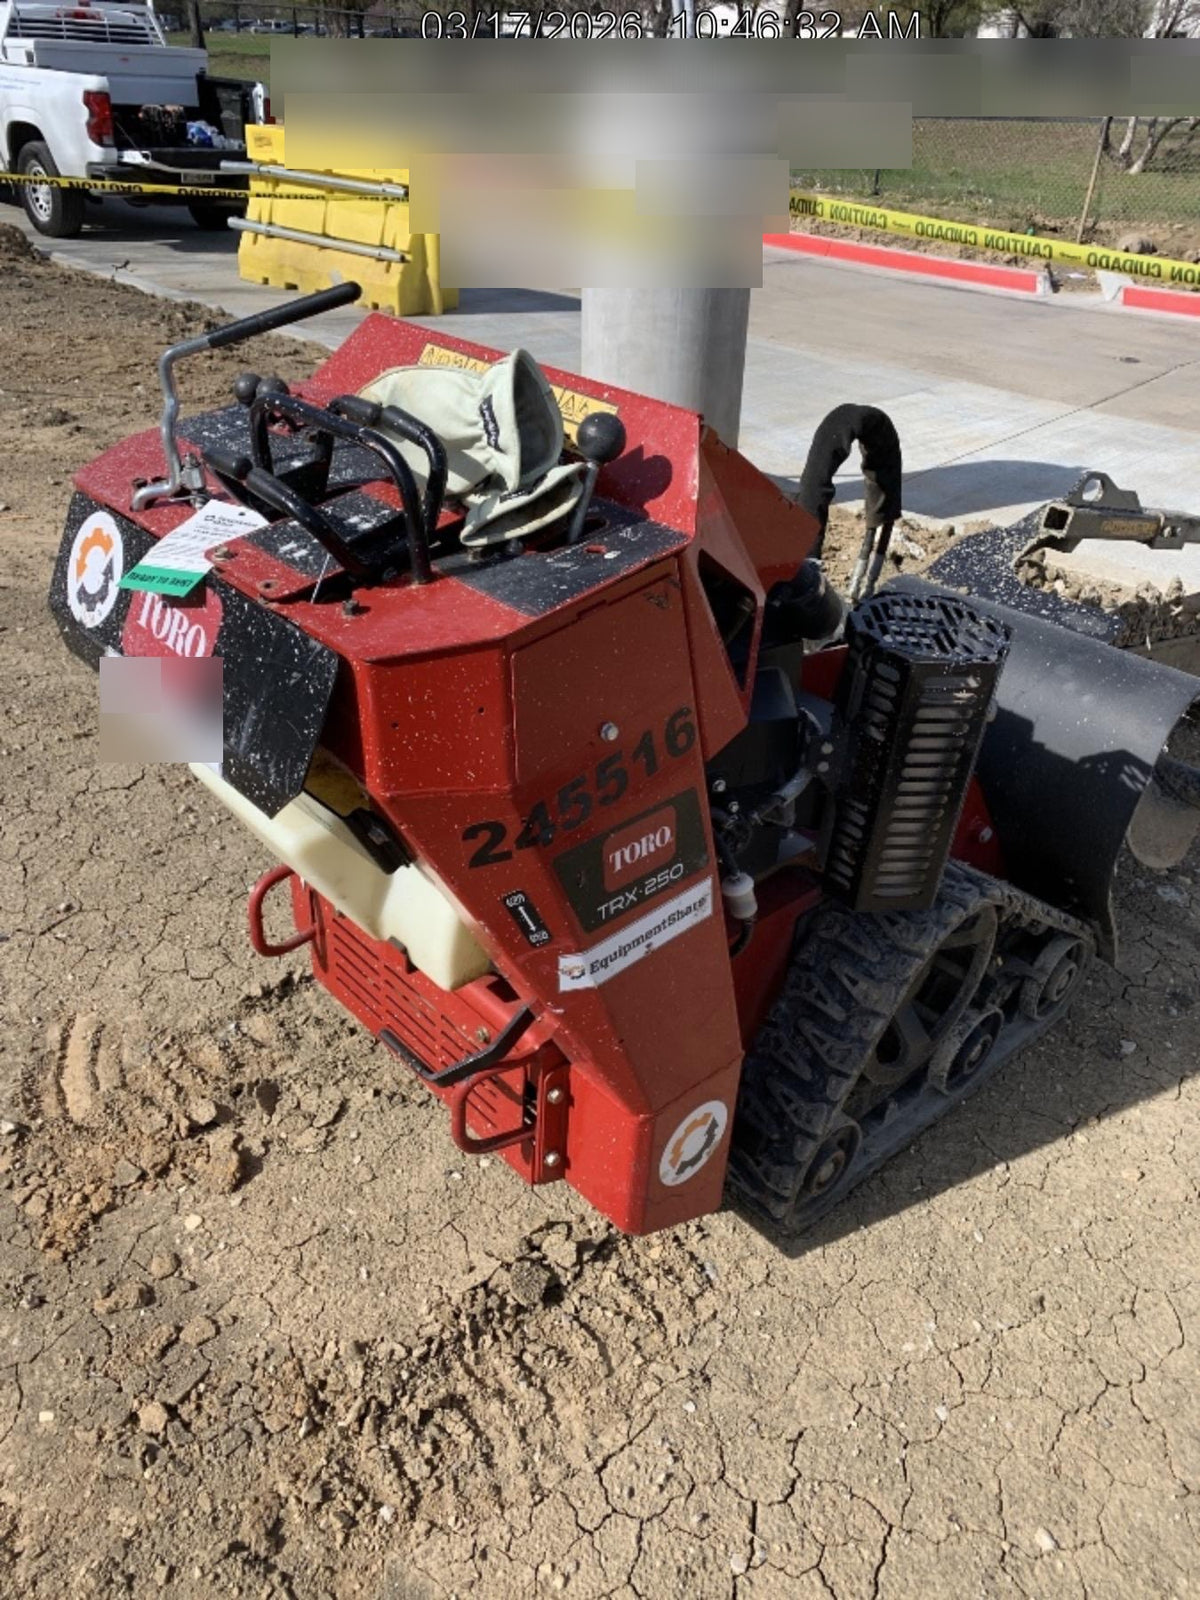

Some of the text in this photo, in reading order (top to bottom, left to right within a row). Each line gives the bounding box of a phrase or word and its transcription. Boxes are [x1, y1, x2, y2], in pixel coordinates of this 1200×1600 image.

[136, 590, 207, 658] TORO
[462, 706, 697, 869] 245516
[608, 825, 673, 874] TORO
[588, 898, 706, 977] EquipmentShare
